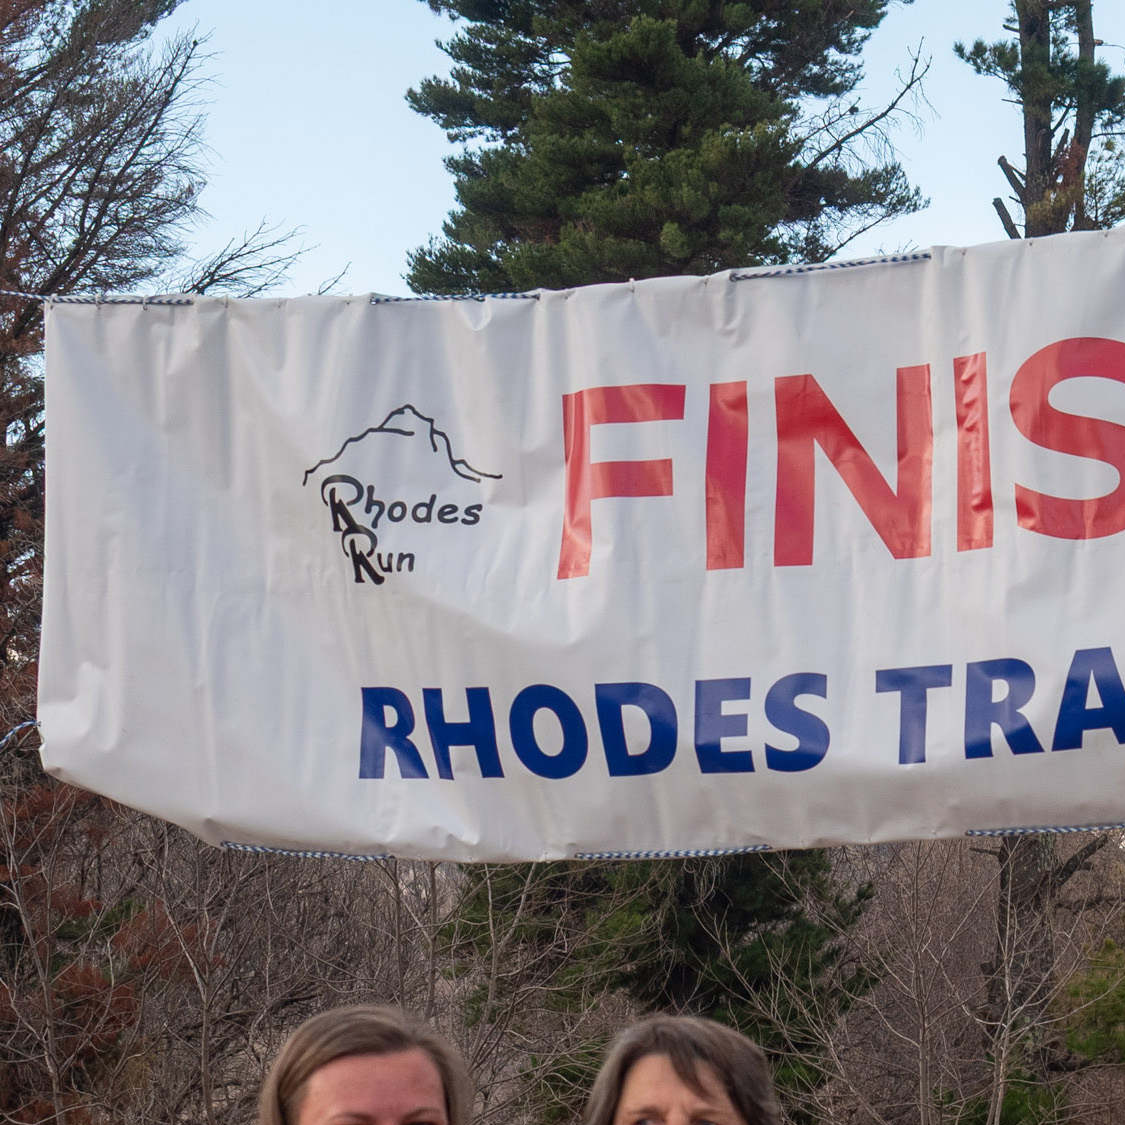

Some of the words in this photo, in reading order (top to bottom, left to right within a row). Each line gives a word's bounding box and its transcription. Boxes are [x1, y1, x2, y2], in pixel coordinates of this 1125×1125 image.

[321, 474, 483, 532] Rhodes
[342, 524, 415, 585] Run
[358, 672, 831, 781] RHODES
